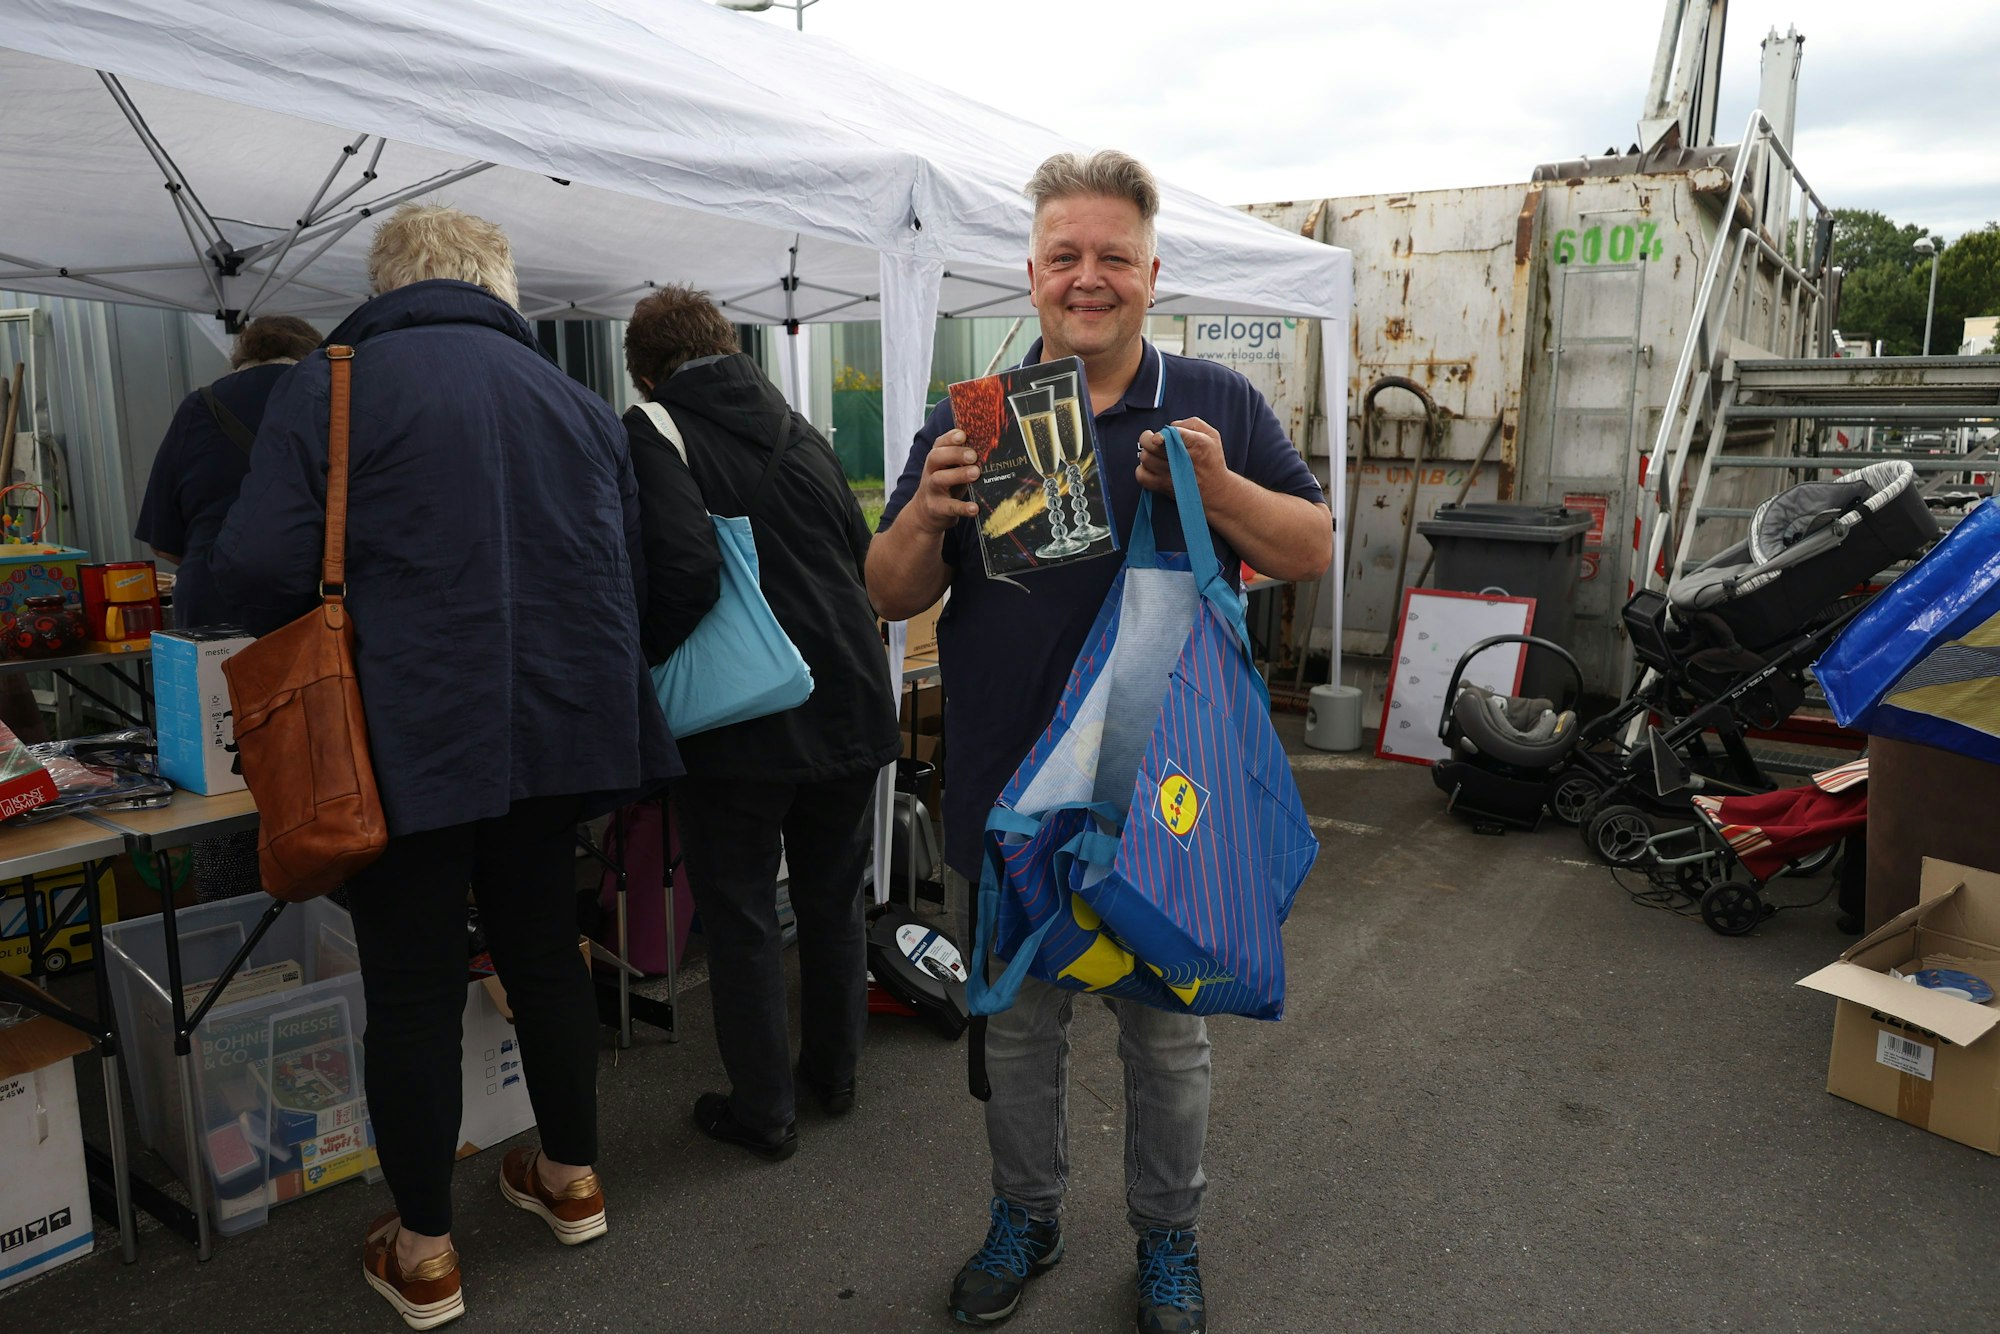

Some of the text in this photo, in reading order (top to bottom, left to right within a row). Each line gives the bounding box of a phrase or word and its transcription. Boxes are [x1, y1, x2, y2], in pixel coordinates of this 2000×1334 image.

[1197, 315, 1282, 348] reloga
[1196, 348, 1281, 362] www.reloga.de
[980, 455, 1028, 474] LLENNIUM
[205, 647, 230, 657] mestic
[16, 945, 30, 955] BU
[278, 1015, 338, 1039] KRESSE
[203, 1057, 216, 1070] &
